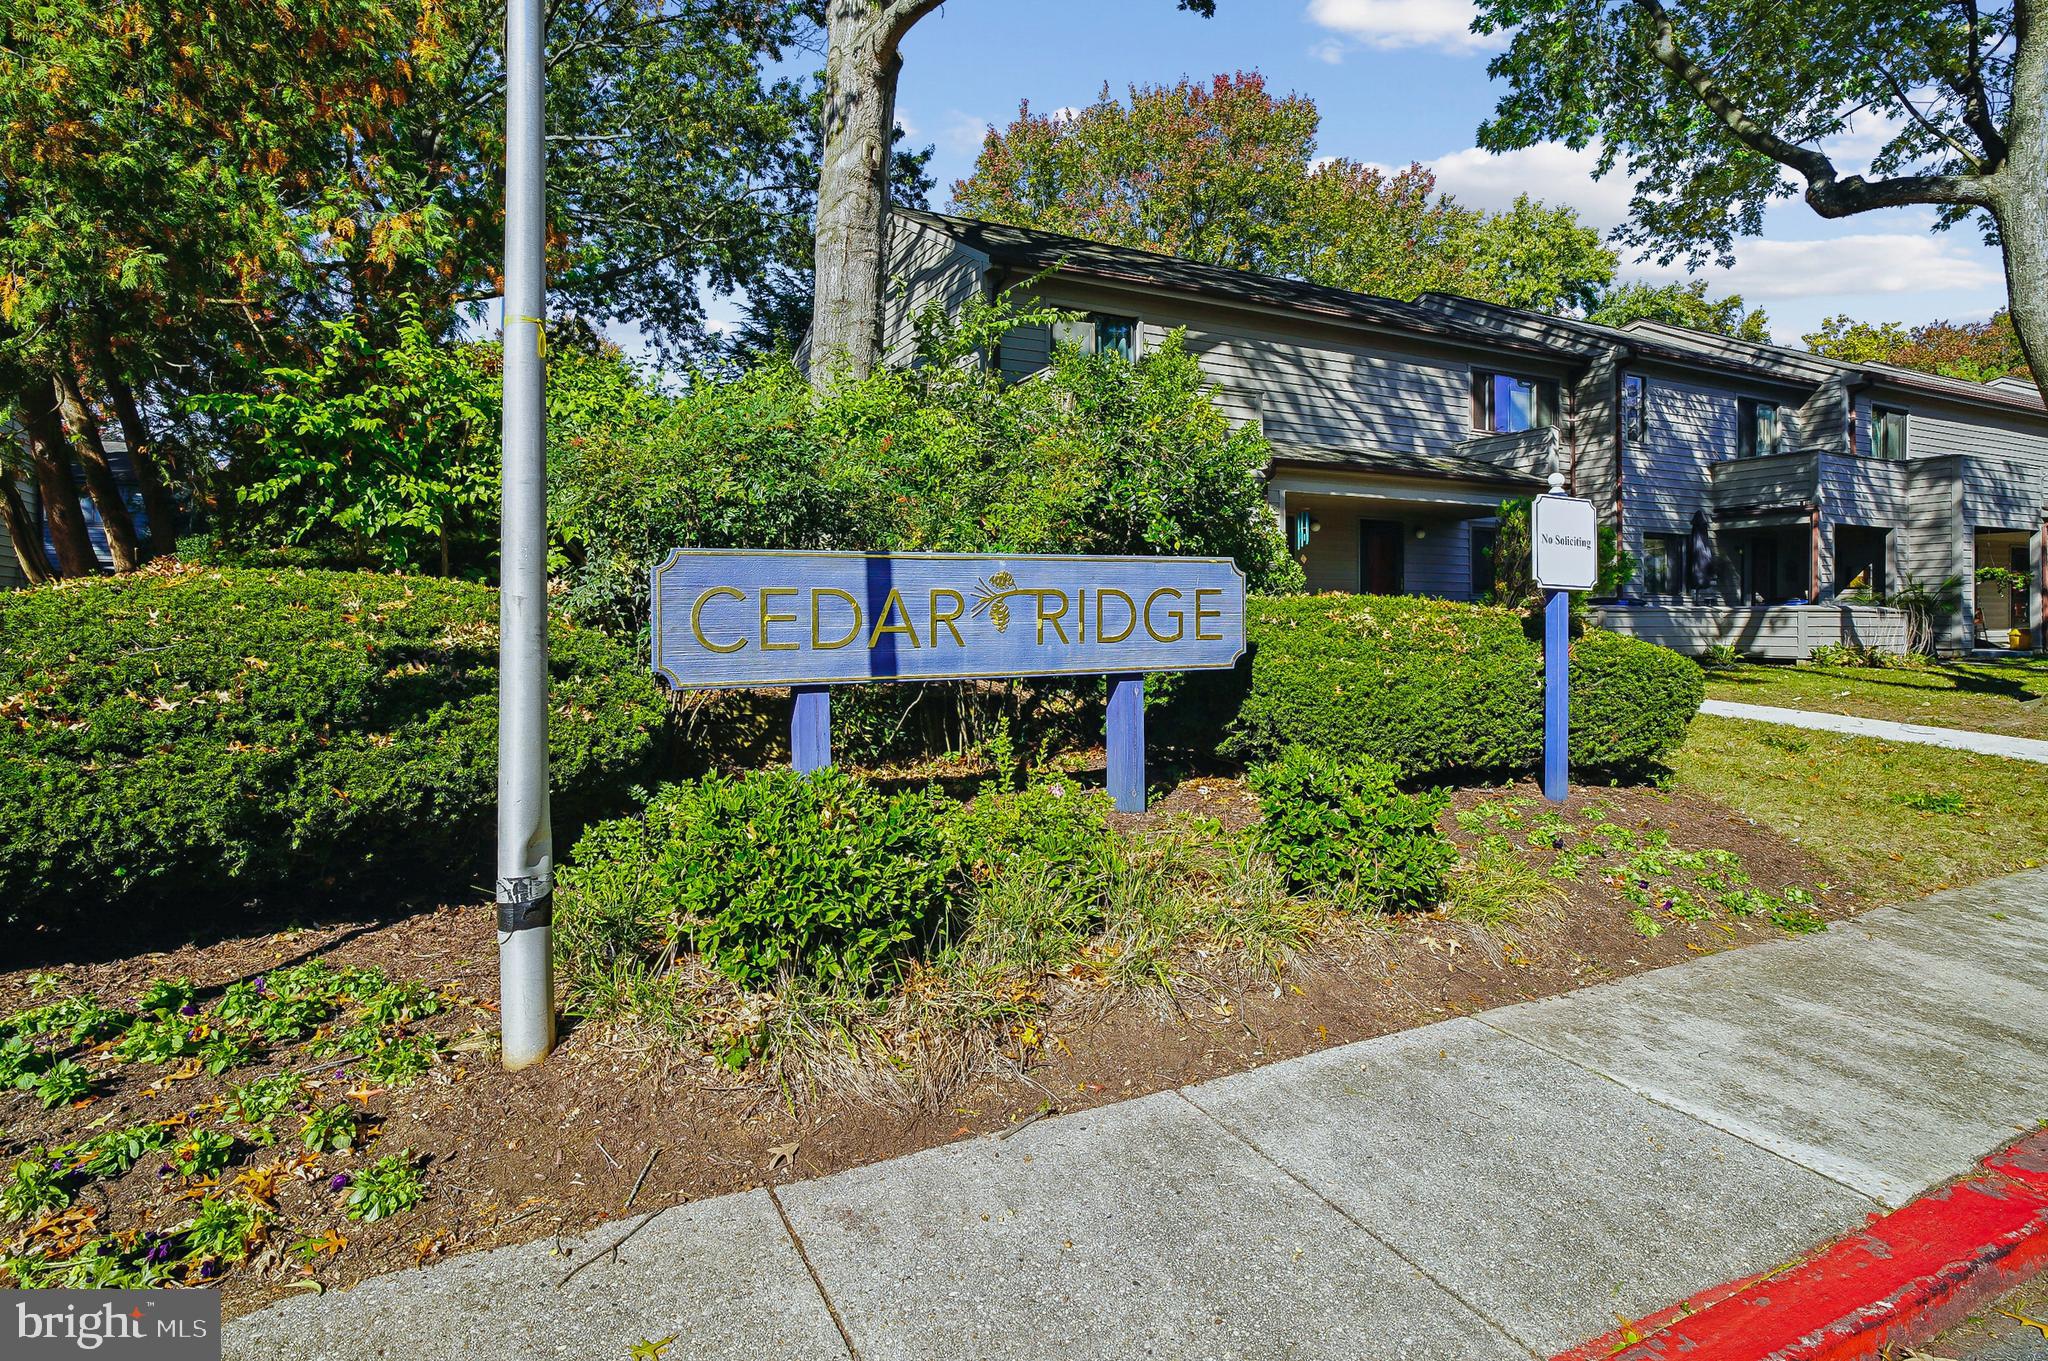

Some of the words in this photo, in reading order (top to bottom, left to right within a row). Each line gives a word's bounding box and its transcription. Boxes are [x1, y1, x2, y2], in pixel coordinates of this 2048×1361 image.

[1541, 533, 1554, 545] No
[1555, 534, 1592, 550] Soliciting
[691, 586, 966, 654] CEDAR
[1036, 587, 1223, 645] RIDGE
